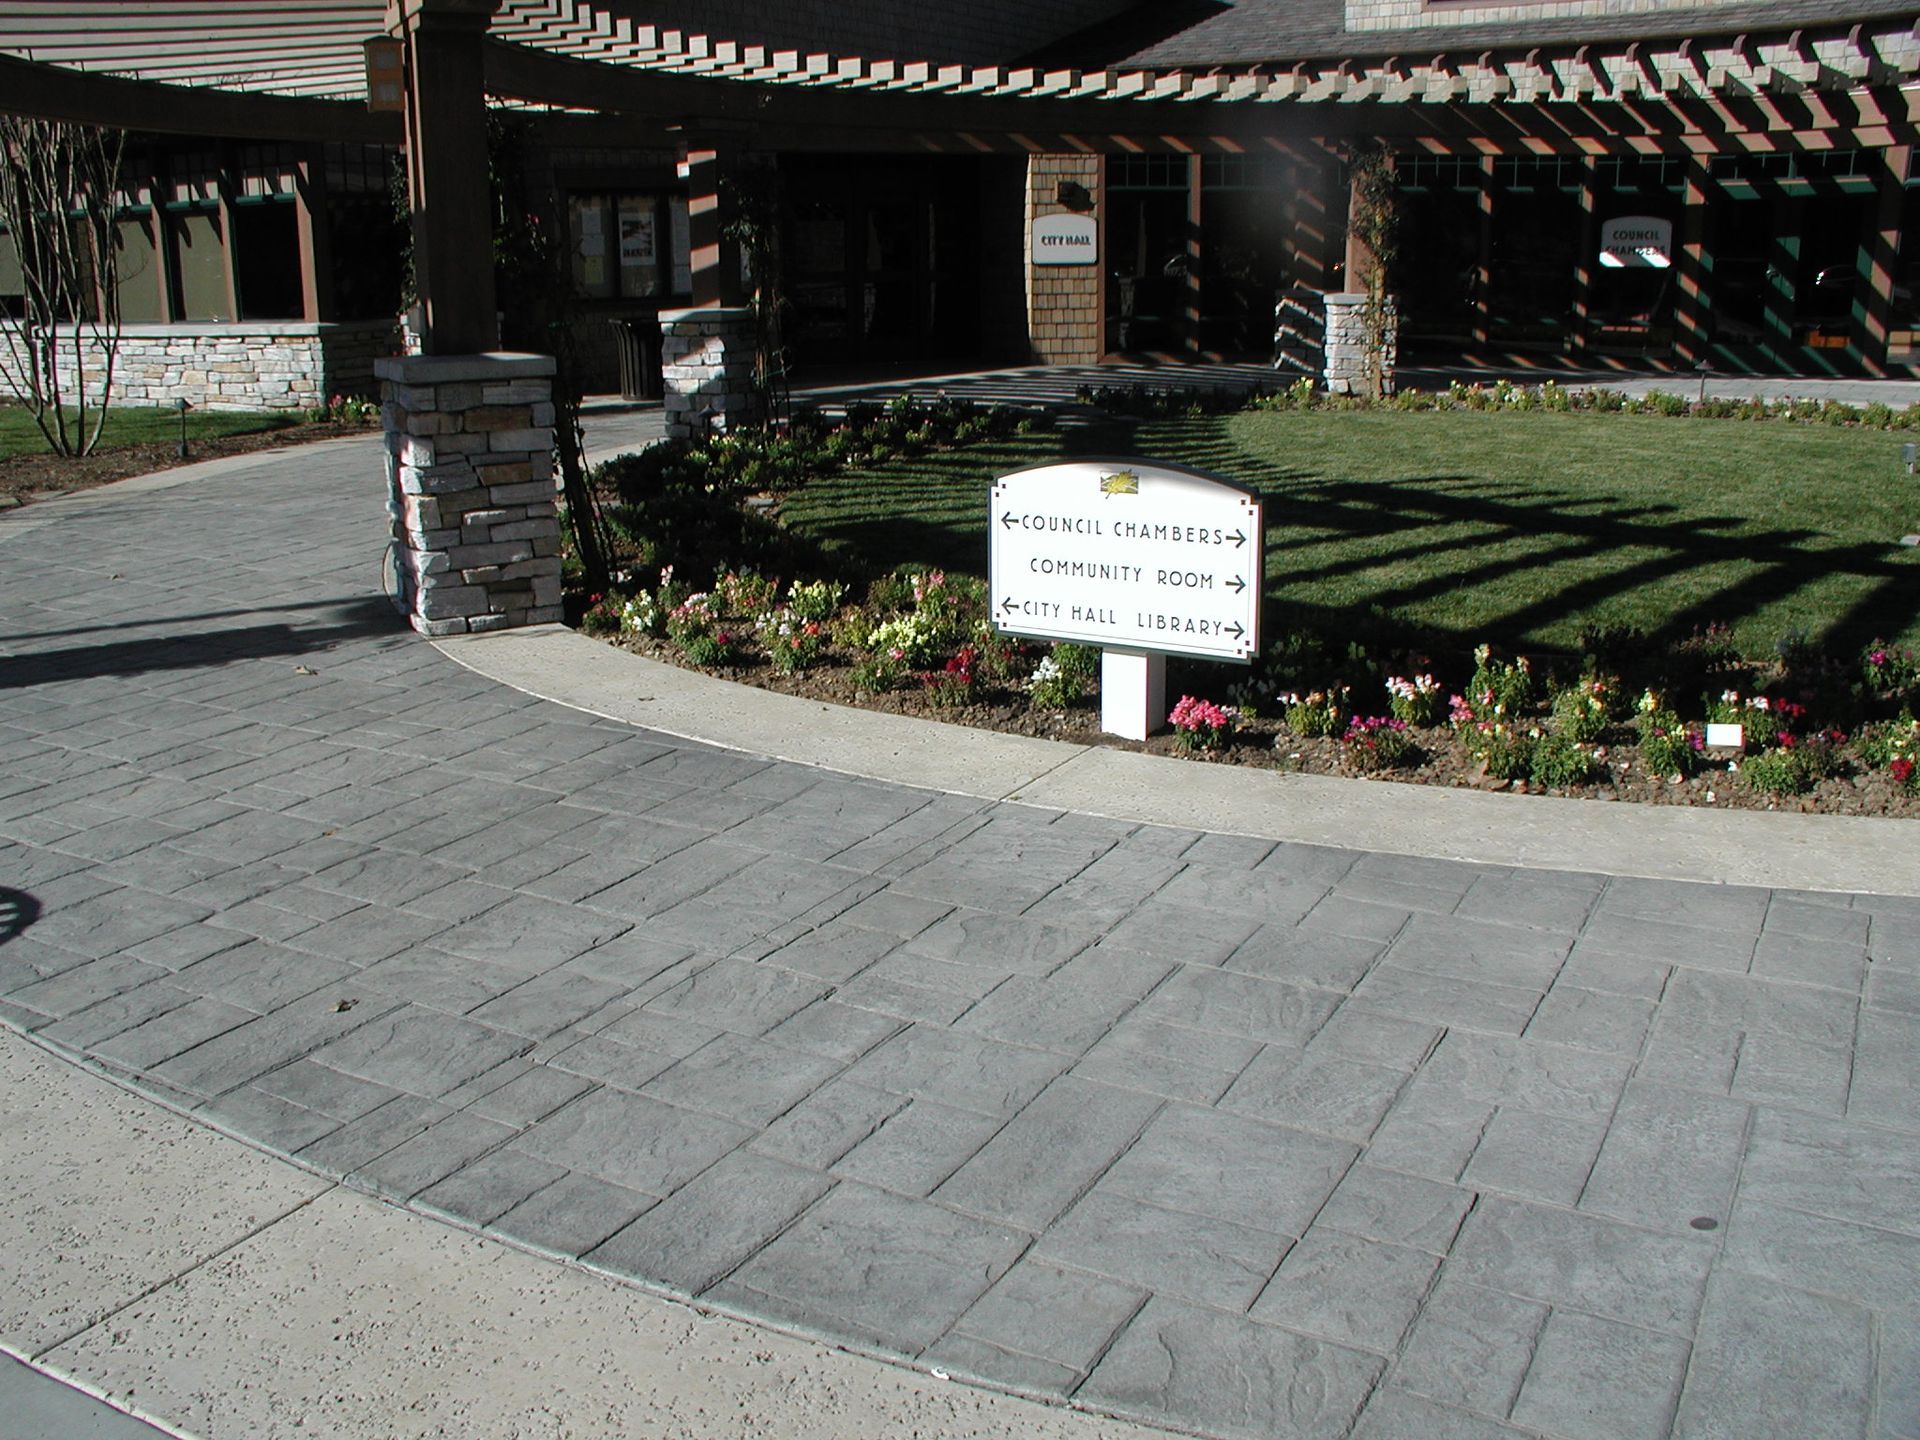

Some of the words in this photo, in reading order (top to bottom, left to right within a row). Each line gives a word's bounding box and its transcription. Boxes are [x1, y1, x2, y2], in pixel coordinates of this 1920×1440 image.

[1041, 234, 1064, 246] CITY
[1066, 234, 1091, 246] HALL
[1612, 230, 1660, 241] COUNCIL
[1022, 514, 1103, 536] COUNCIL
[1114, 521, 1223, 545] CHAMBERS
[1030, 558, 1142, 582] COMMUNITY
[1157, 569, 1213, 589] ROOM
[1023, 600, 1060, 618] CITY
[1071, 605, 1117, 625] HALL
[1137, 612, 1222, 636] LIBRARY
